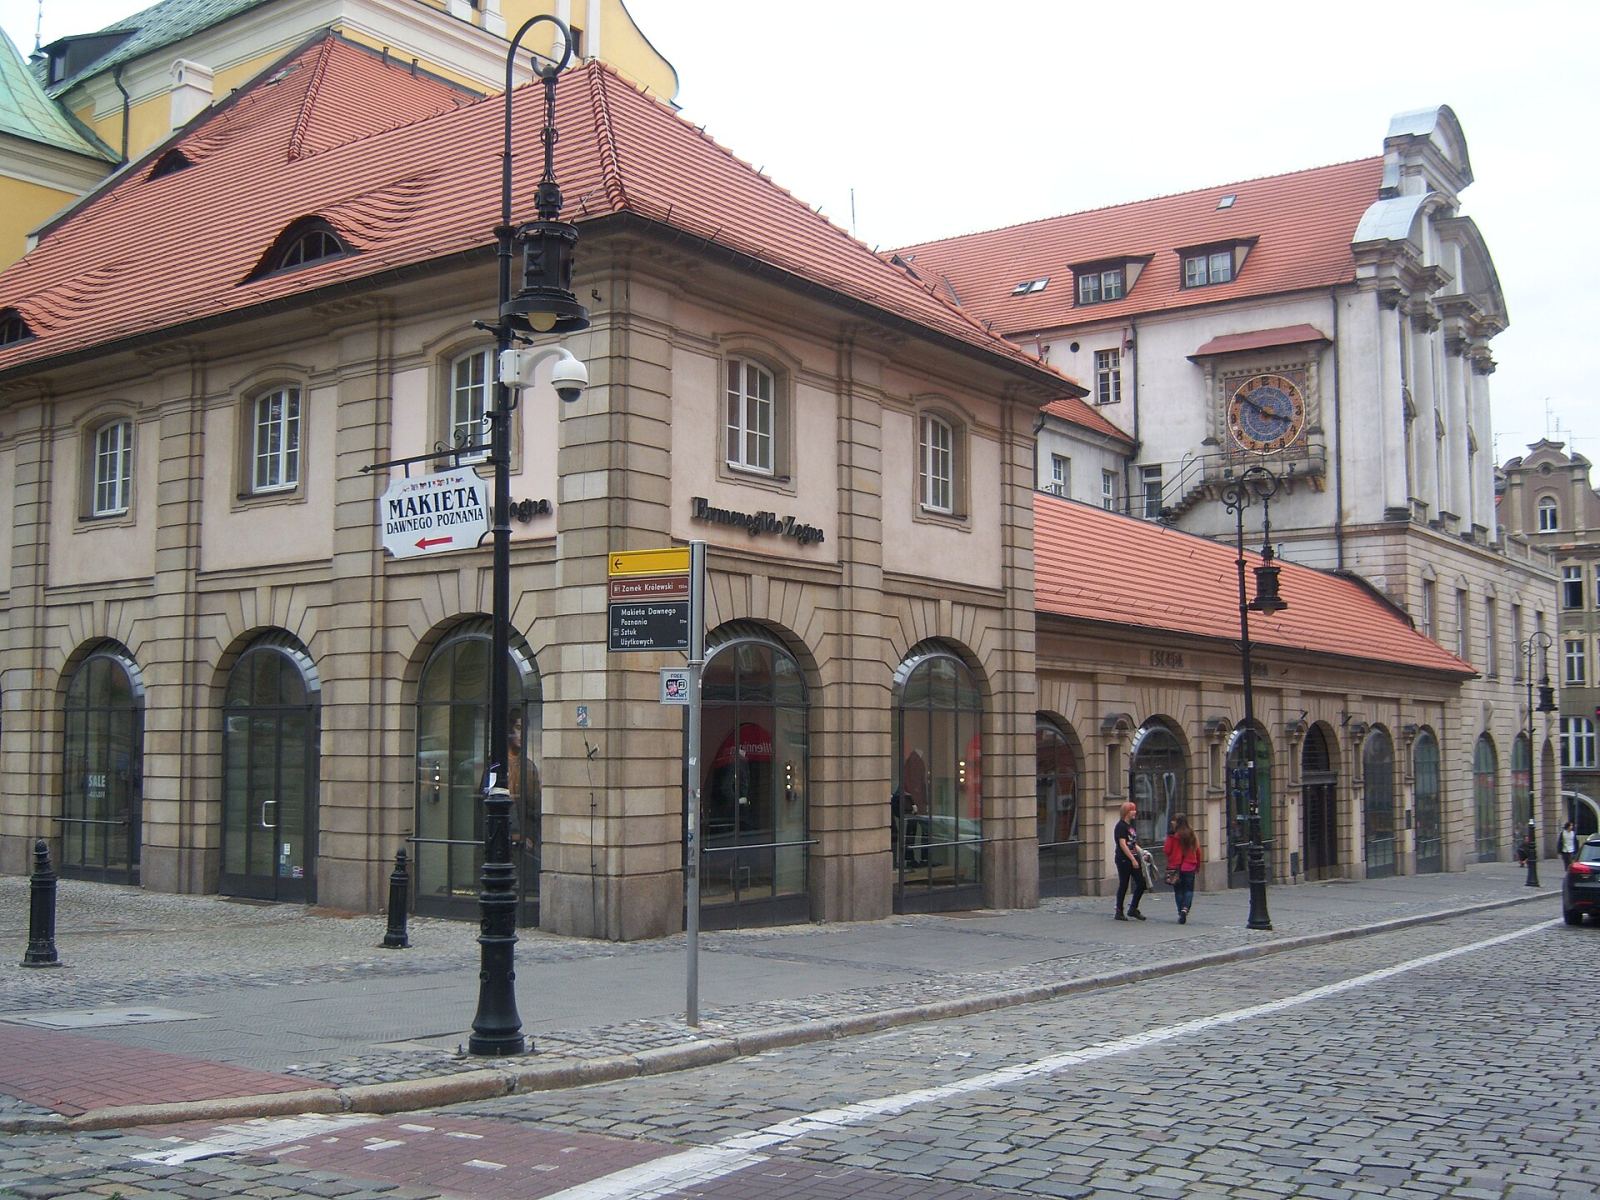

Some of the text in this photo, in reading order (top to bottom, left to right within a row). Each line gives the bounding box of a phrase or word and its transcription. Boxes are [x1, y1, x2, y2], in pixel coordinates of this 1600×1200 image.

[389, 486, 480, 520] MAKIETA
[507, 498, 554, 524] egna
[386, 507, 484, 535] DAWNEGO POZNANIA
[621, 585, 641, 593] Zamek
[644, 582, 674, 592] Królewski
[620, 607, 677, 617] Makieta Dawnego
[620, 618, 648, 627] Poznania
[620, 628, 637, 637] Sztuk
[620, 637, 654, 647] Użytkowych
[88, 775, 105, 787] SALE
